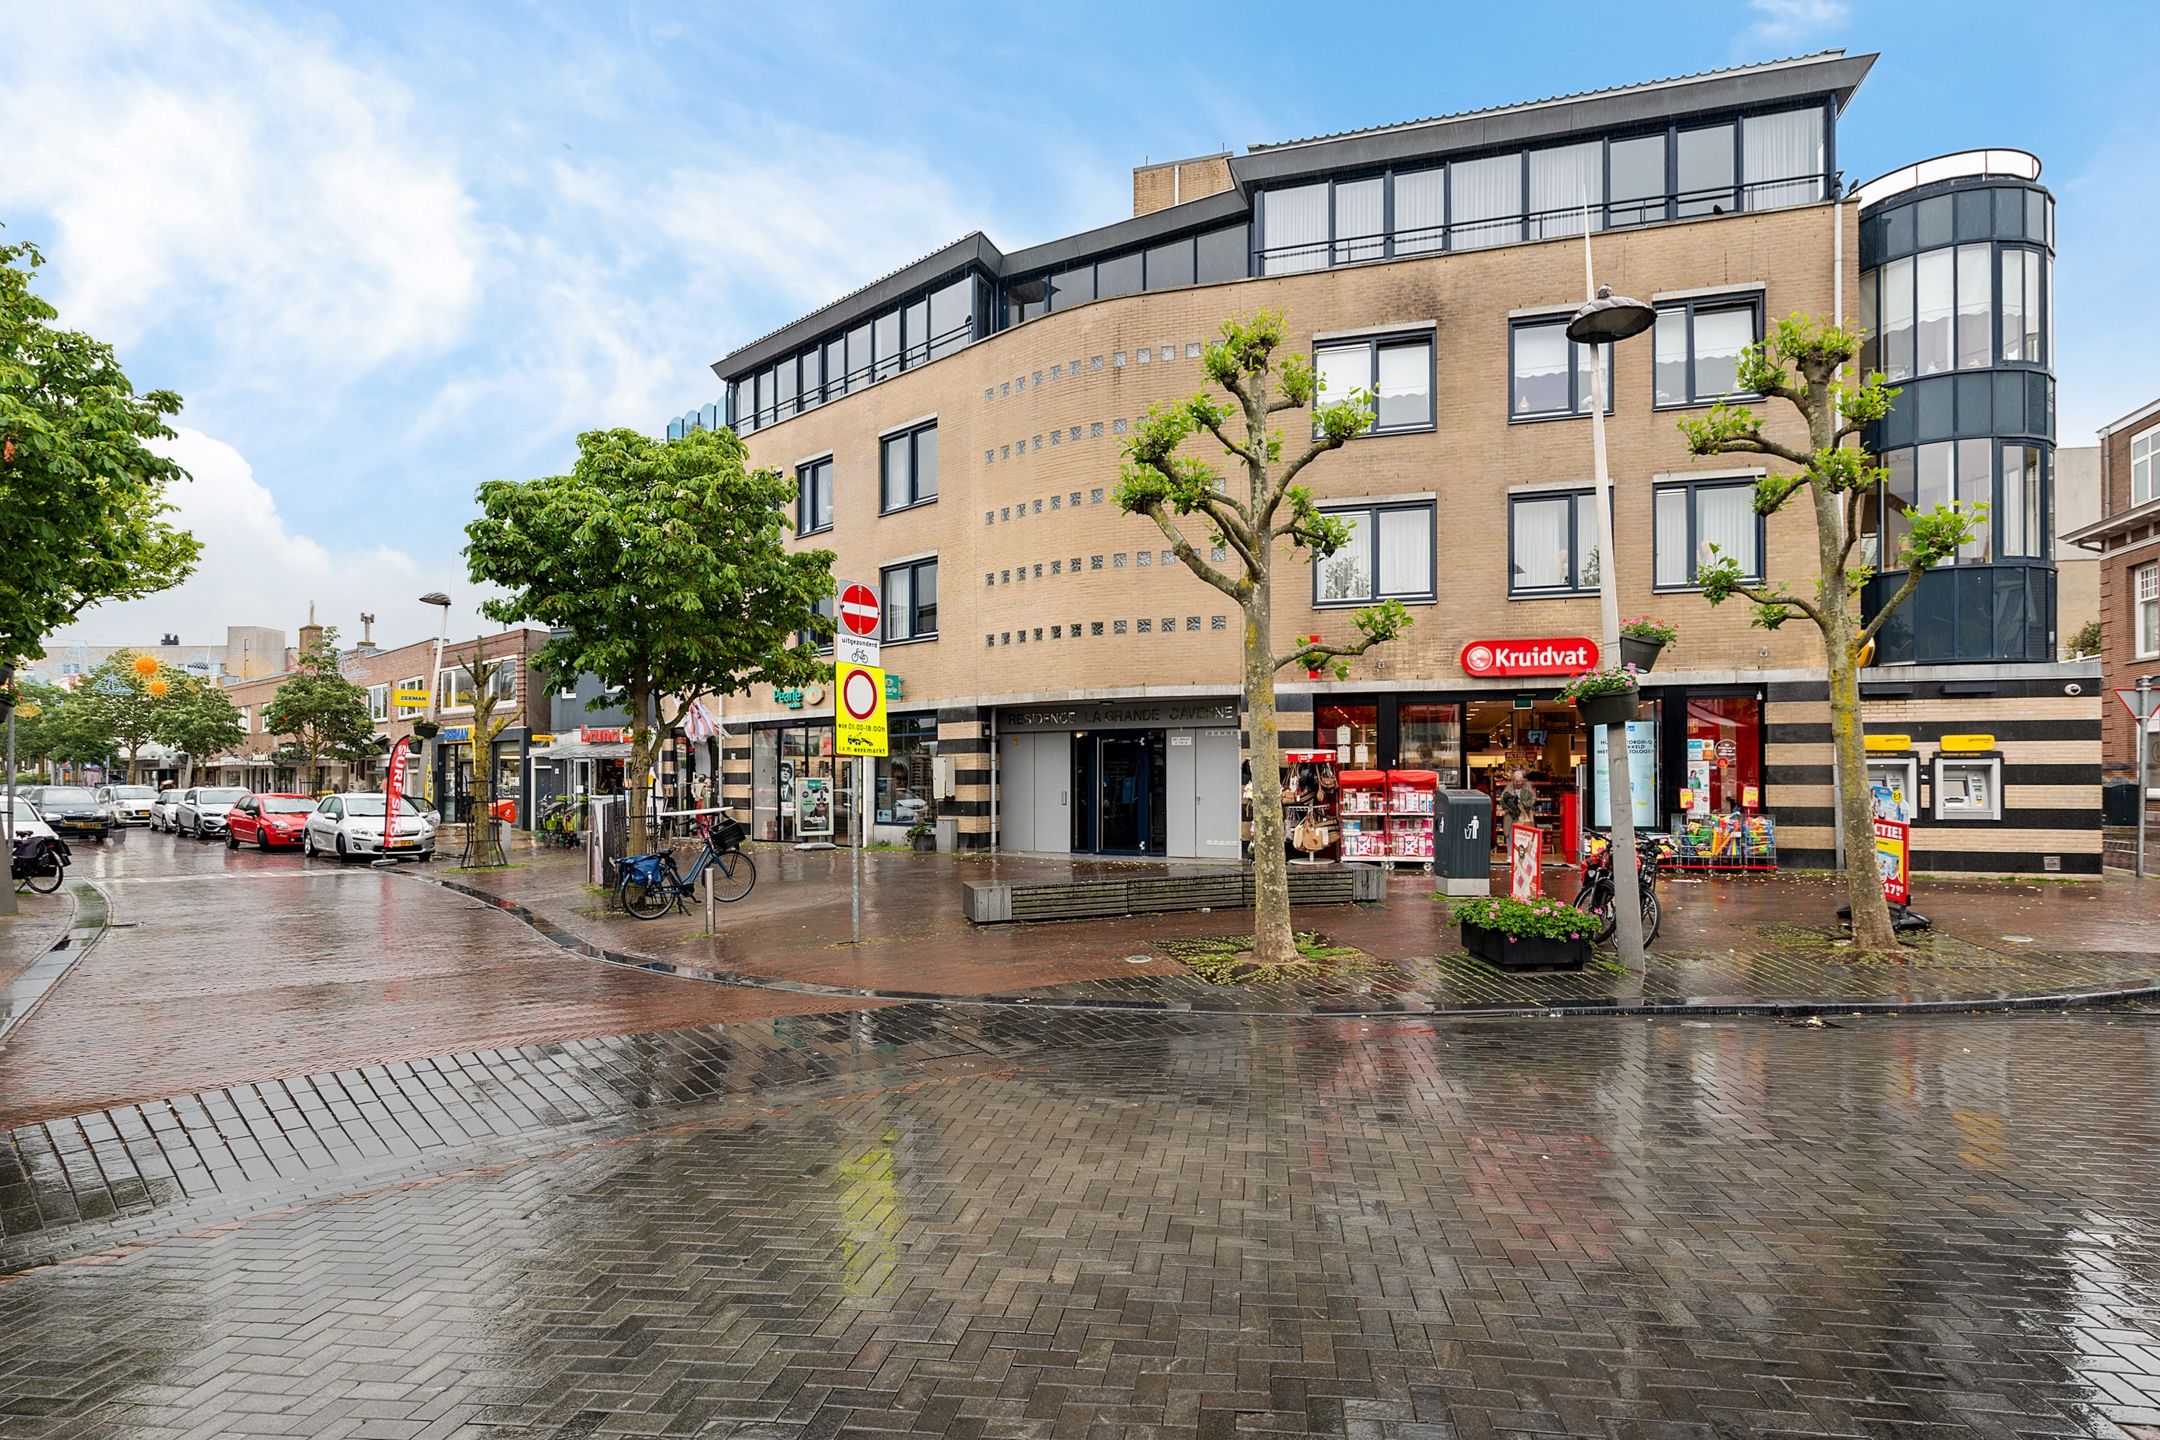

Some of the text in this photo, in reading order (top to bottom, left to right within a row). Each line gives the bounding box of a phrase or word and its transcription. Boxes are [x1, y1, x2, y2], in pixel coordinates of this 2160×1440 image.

[841, 637, 878, 648] uitgezonderd
[1495, 646, 1588, 667] Kruidvat
[773, 688, 803, 702] Pearle
[1008, 705, 1233, 725] RESIDENCE LA GRANDE CAVERNE
[393, 744, 408, 793] SURF
[1874, 822, 1903, 840] CTIE!
